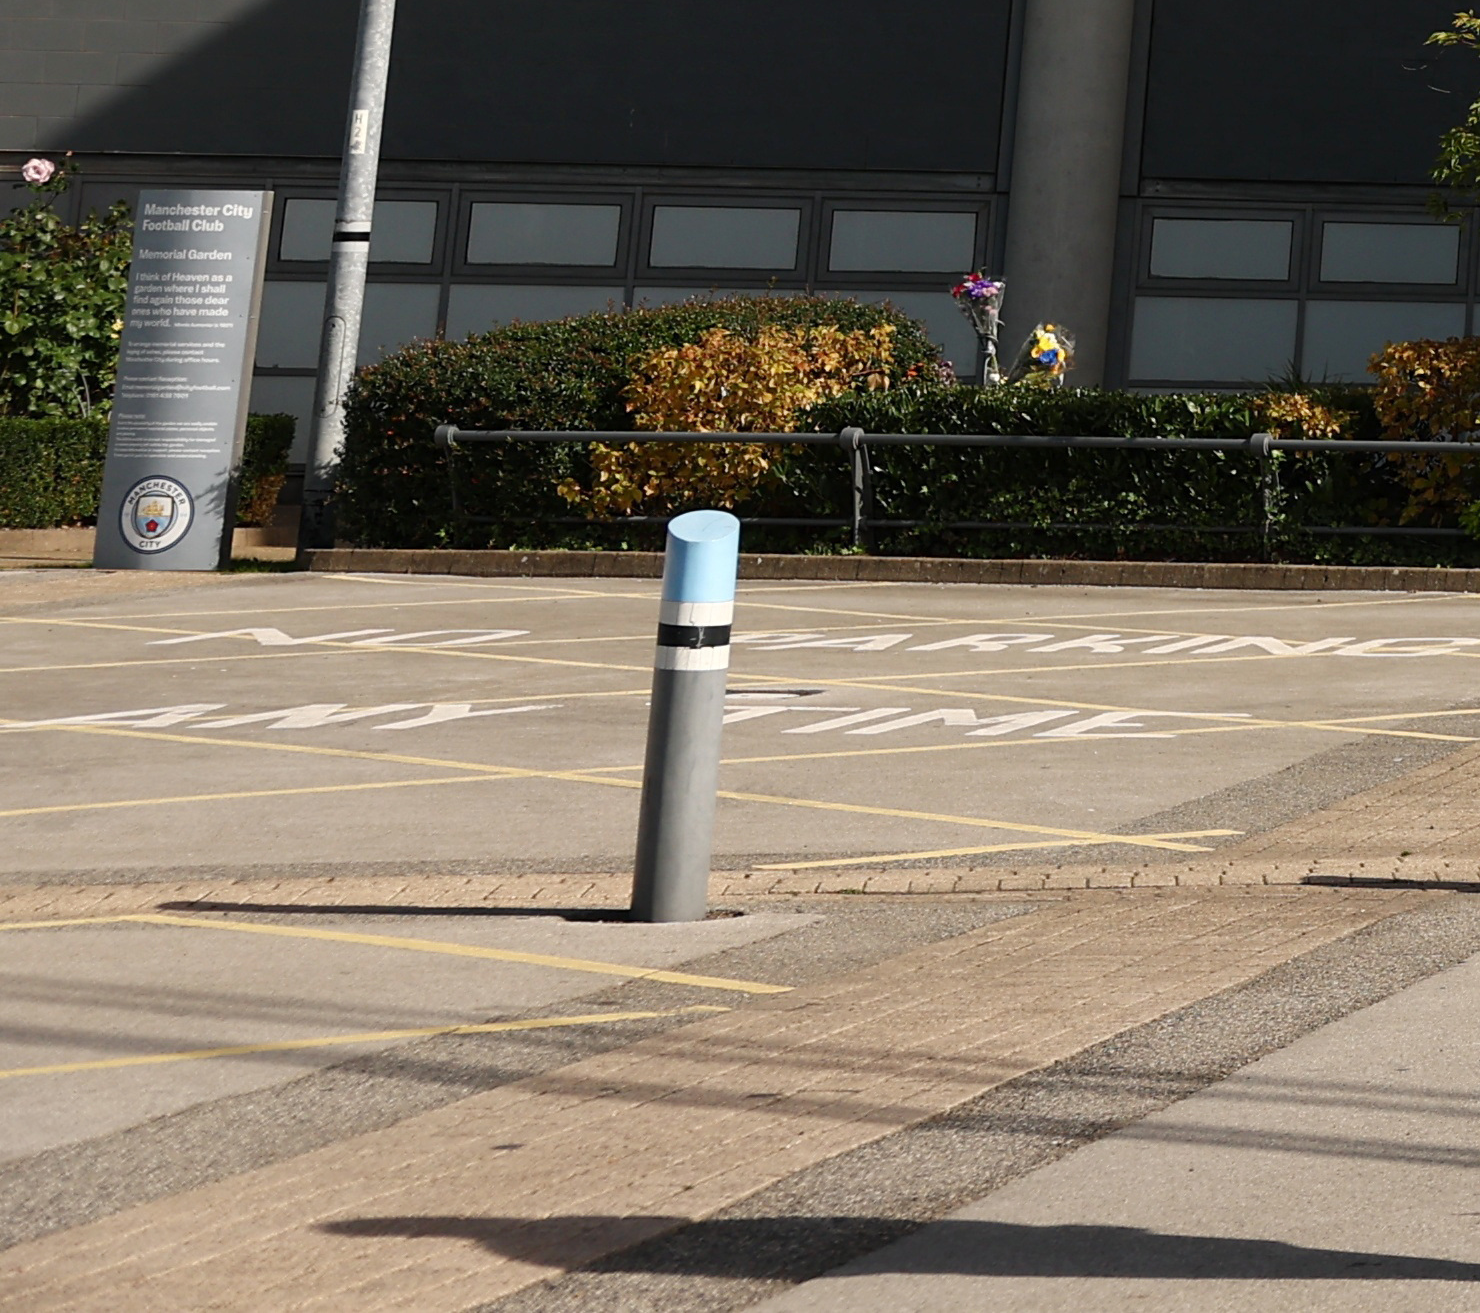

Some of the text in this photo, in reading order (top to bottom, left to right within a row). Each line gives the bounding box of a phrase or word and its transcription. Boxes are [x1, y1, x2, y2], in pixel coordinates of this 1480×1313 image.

[144, 204, 253, 219] Manchester City
[142, 220, 225, 231] Football Club
[139, 249, 232, 260] Memorial Garden
[140, 273, 160, 281] think
[161, 273, 172, 281] of
[172, 273, 209, 282] Heaven
[134, 284, 162, 294] garden
[164, 284, 195, 293] where
[201, 284, 226, 294] shall
[133, 295, 229, 306] find again those dear
[152, 308, 172, 316] who
[173, 308, 198, 316] have
[198, 308, 229, 316] made
[130, 320, 143, 328] my
[144, 319, 171, 327] world.
[128, 481, 186, 506] MANCHESTER
[138, 540, 162, 548] CITY
[146, 627, 531, 648] NO
[0, 703, 1253, 738] ANY TIME
